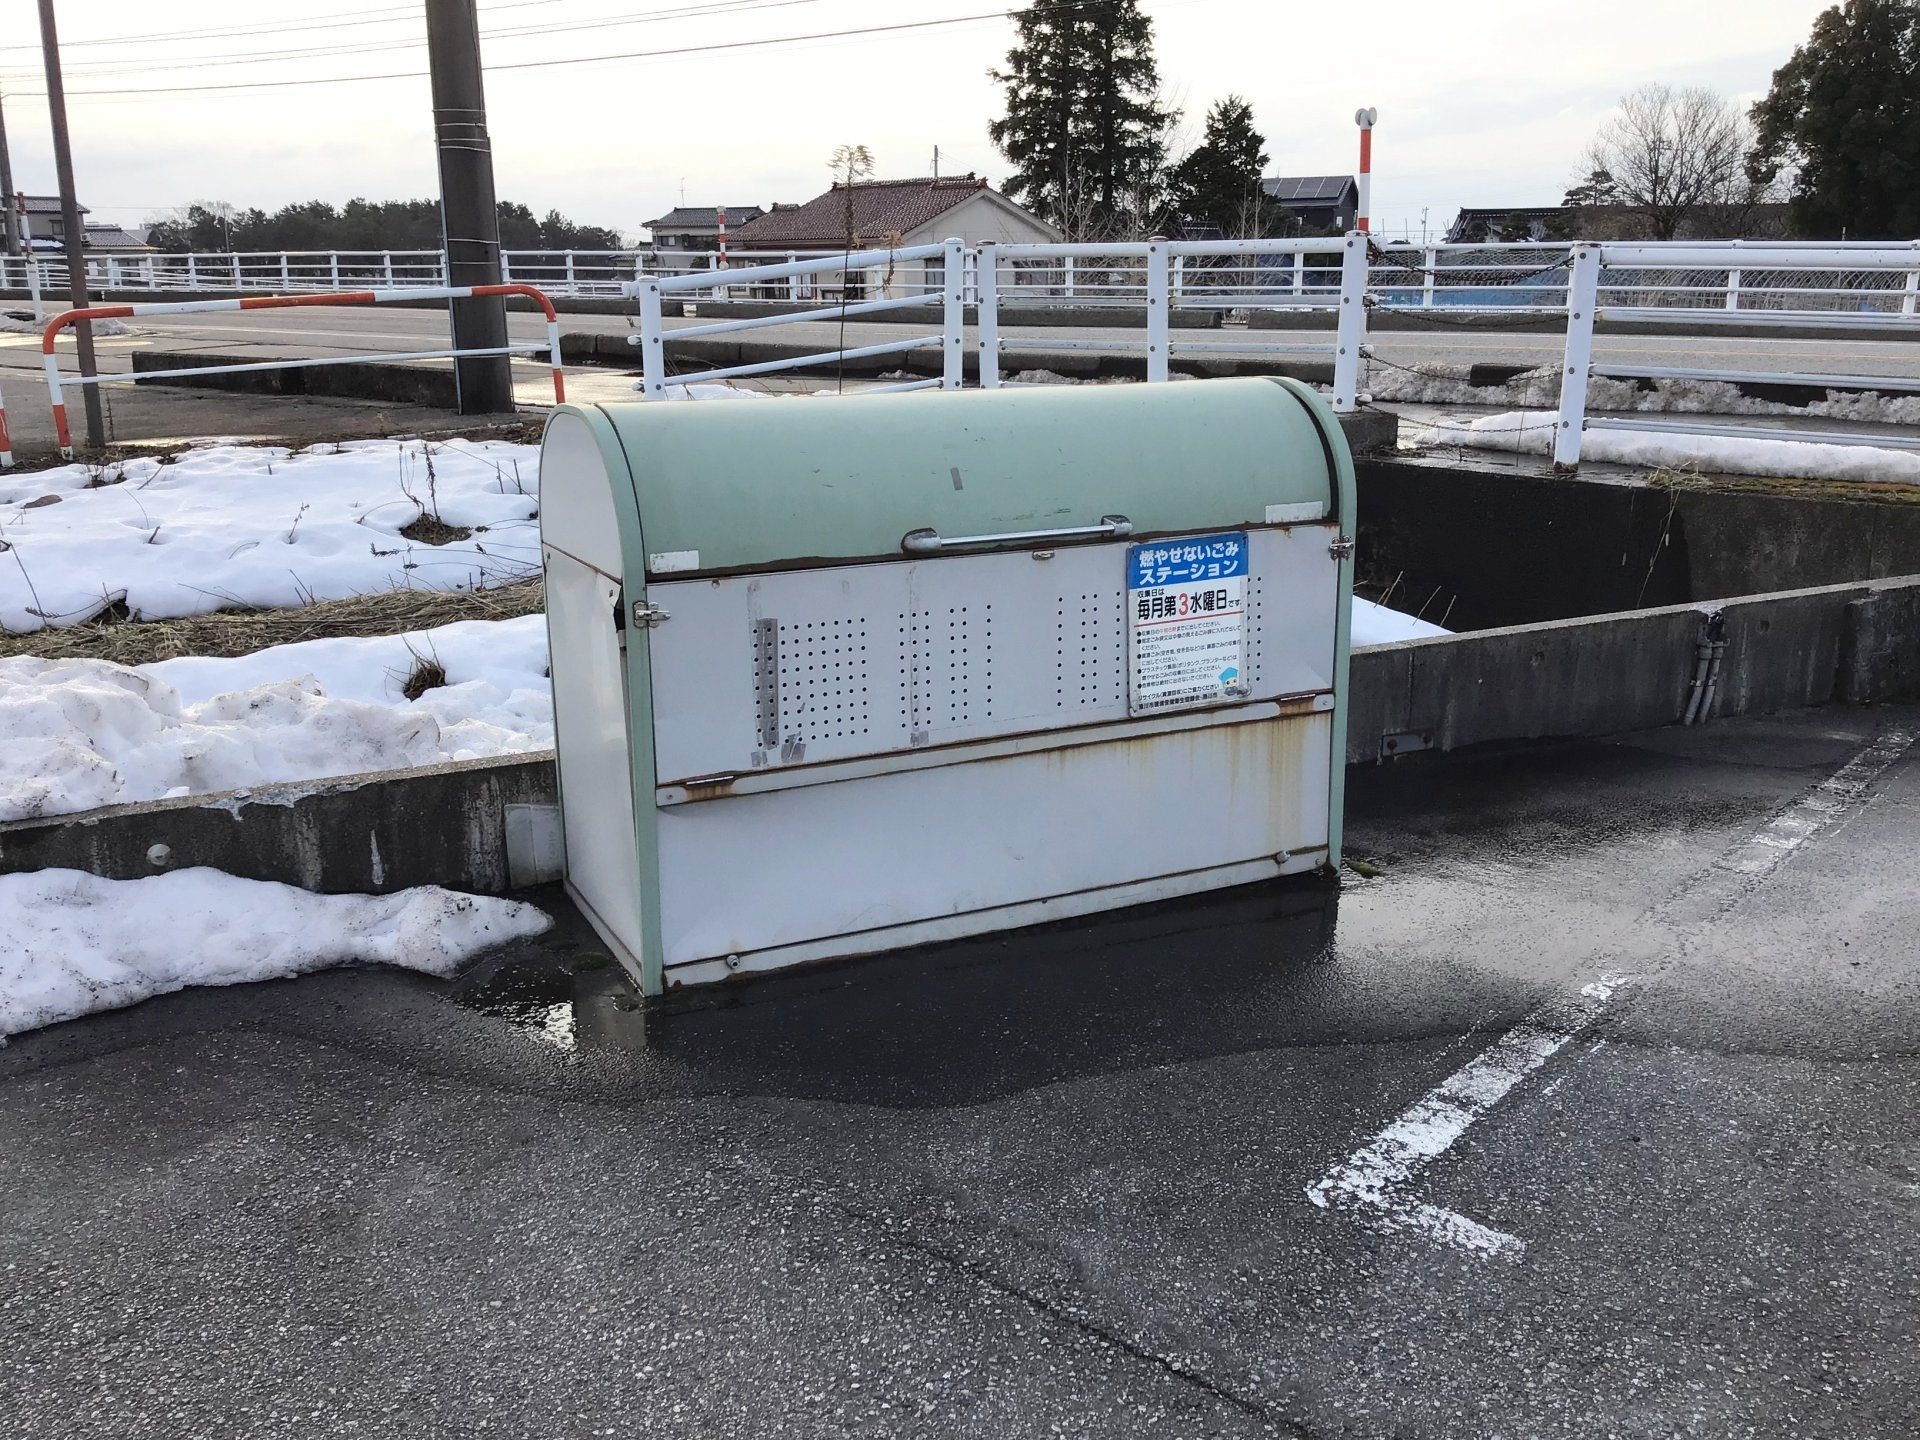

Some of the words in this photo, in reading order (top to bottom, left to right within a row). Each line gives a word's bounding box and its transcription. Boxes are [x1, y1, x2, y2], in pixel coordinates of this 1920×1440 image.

[1139, 541, 1239, 567] 燃やせないごみ
[1139, 560, 1239, 585] ステーション
[1137, 588, 1165, 598] 収集日は
